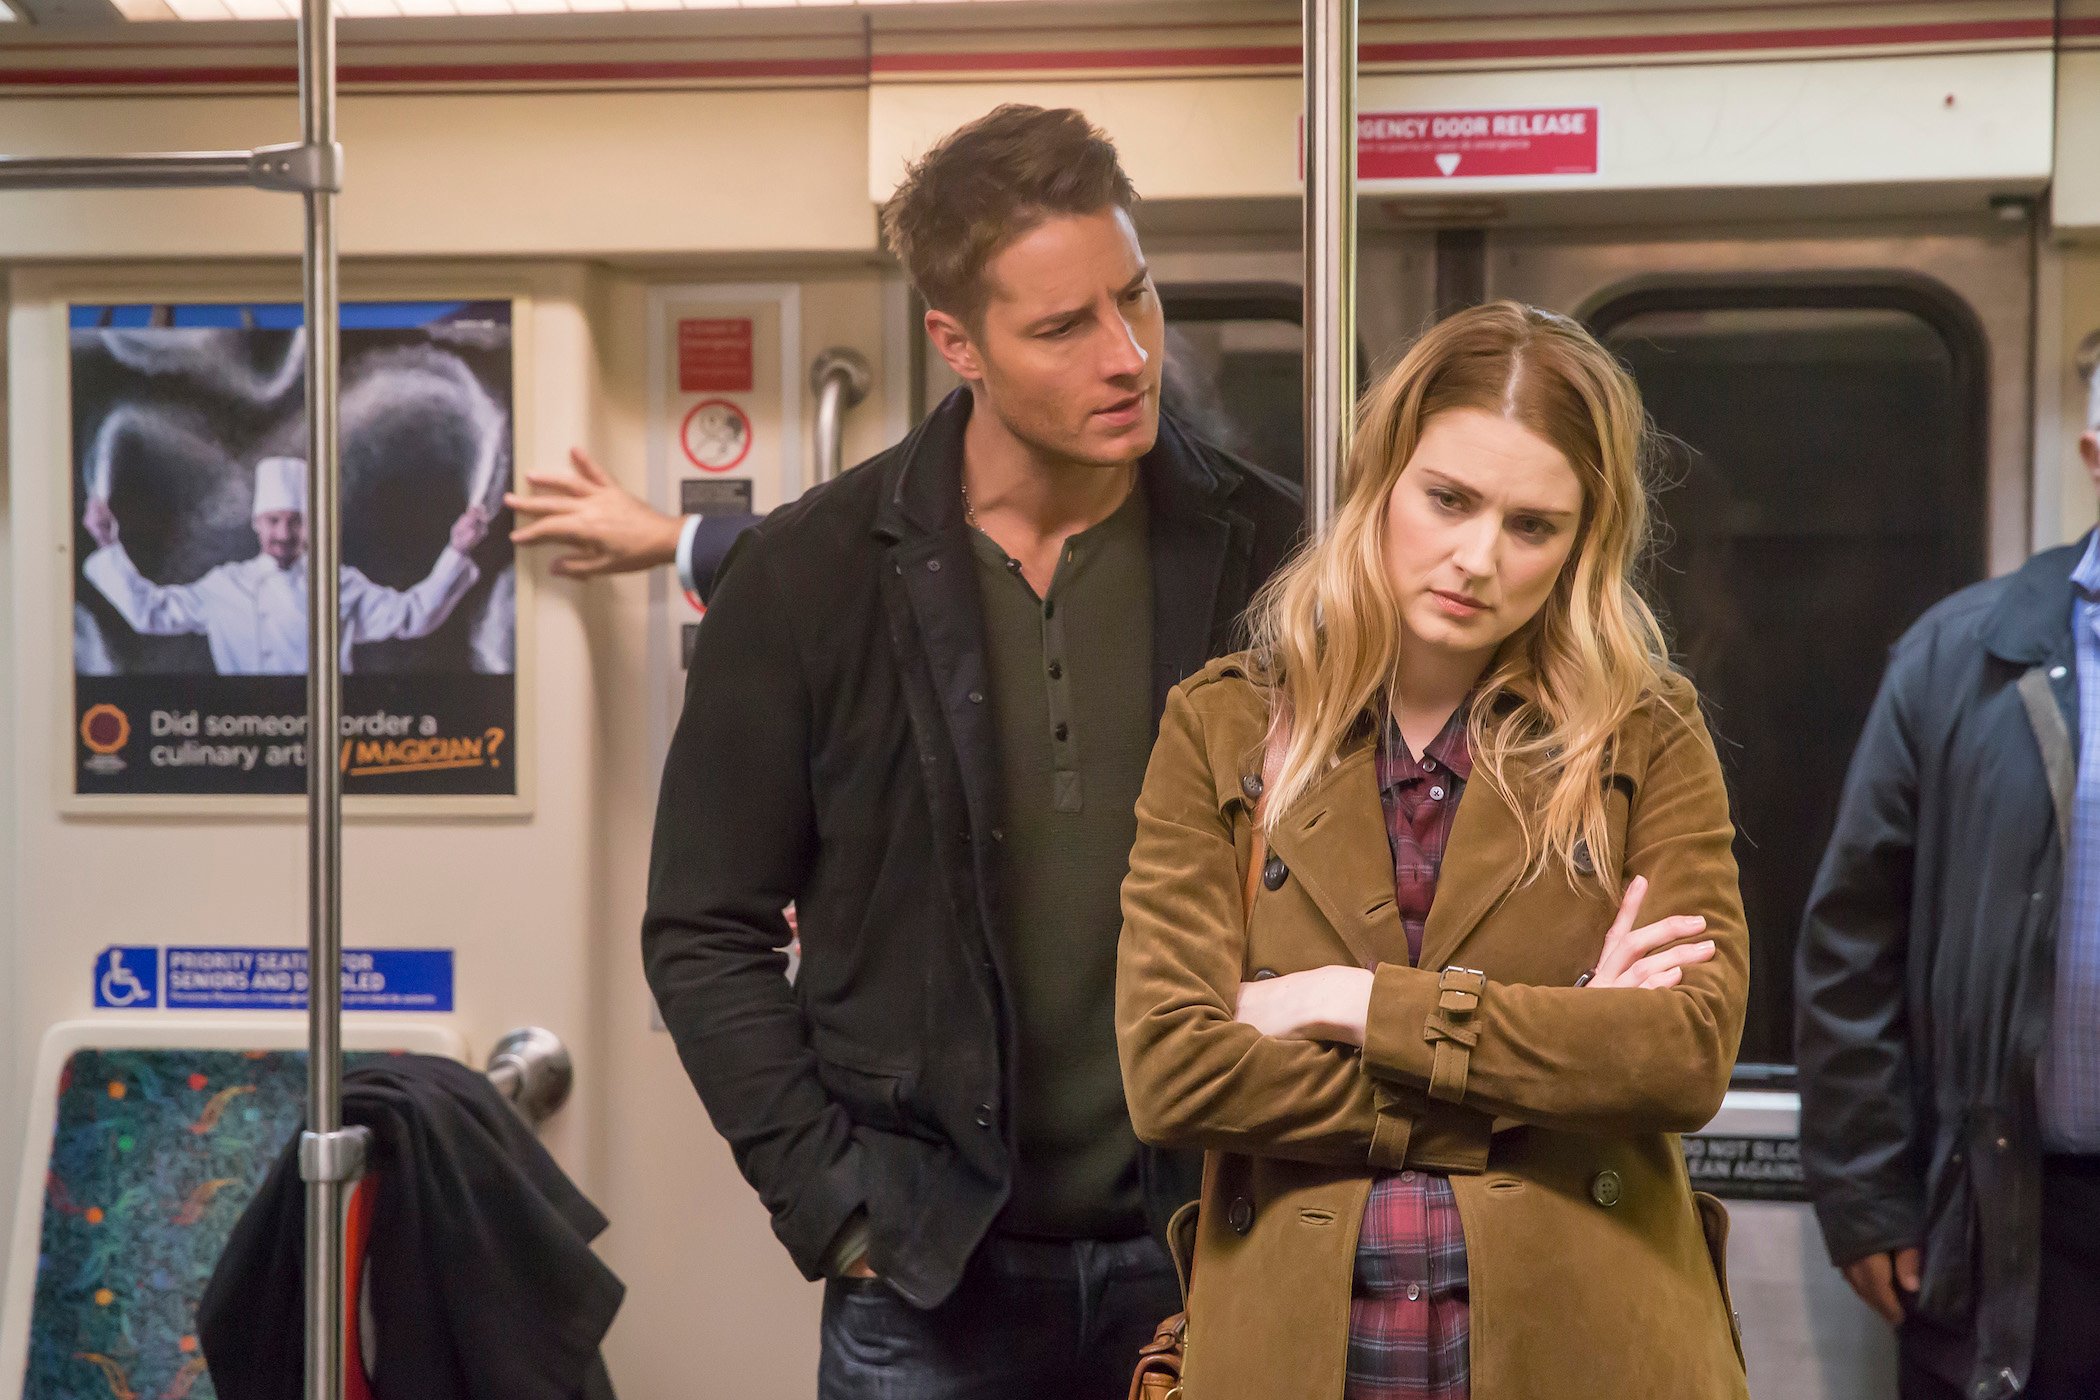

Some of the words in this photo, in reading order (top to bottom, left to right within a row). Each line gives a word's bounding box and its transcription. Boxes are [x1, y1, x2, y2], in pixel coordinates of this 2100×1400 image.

[1432, 116, 1488, 138] DOOR
[1492, 113, 1586, 136] RELEASE
[150, 709, 199, 737] Did
[205, 714, 308, 737] someon
[338, 709, 414, 737] order
[418, 714, 438, 737] a
[151, 738, 261, 771] culinary
[265, 741, 308, 767] art
[169, 951, 254, 972] PRIORITY
[255, 951, 310, 972] SEATI
[169, 970, 250, 991] SENIORS
[251, 971, 292, 992] AND
[1708, 1139, 1748, 1159] NOT
[1688, 1158, 1730, 1179] EAN
